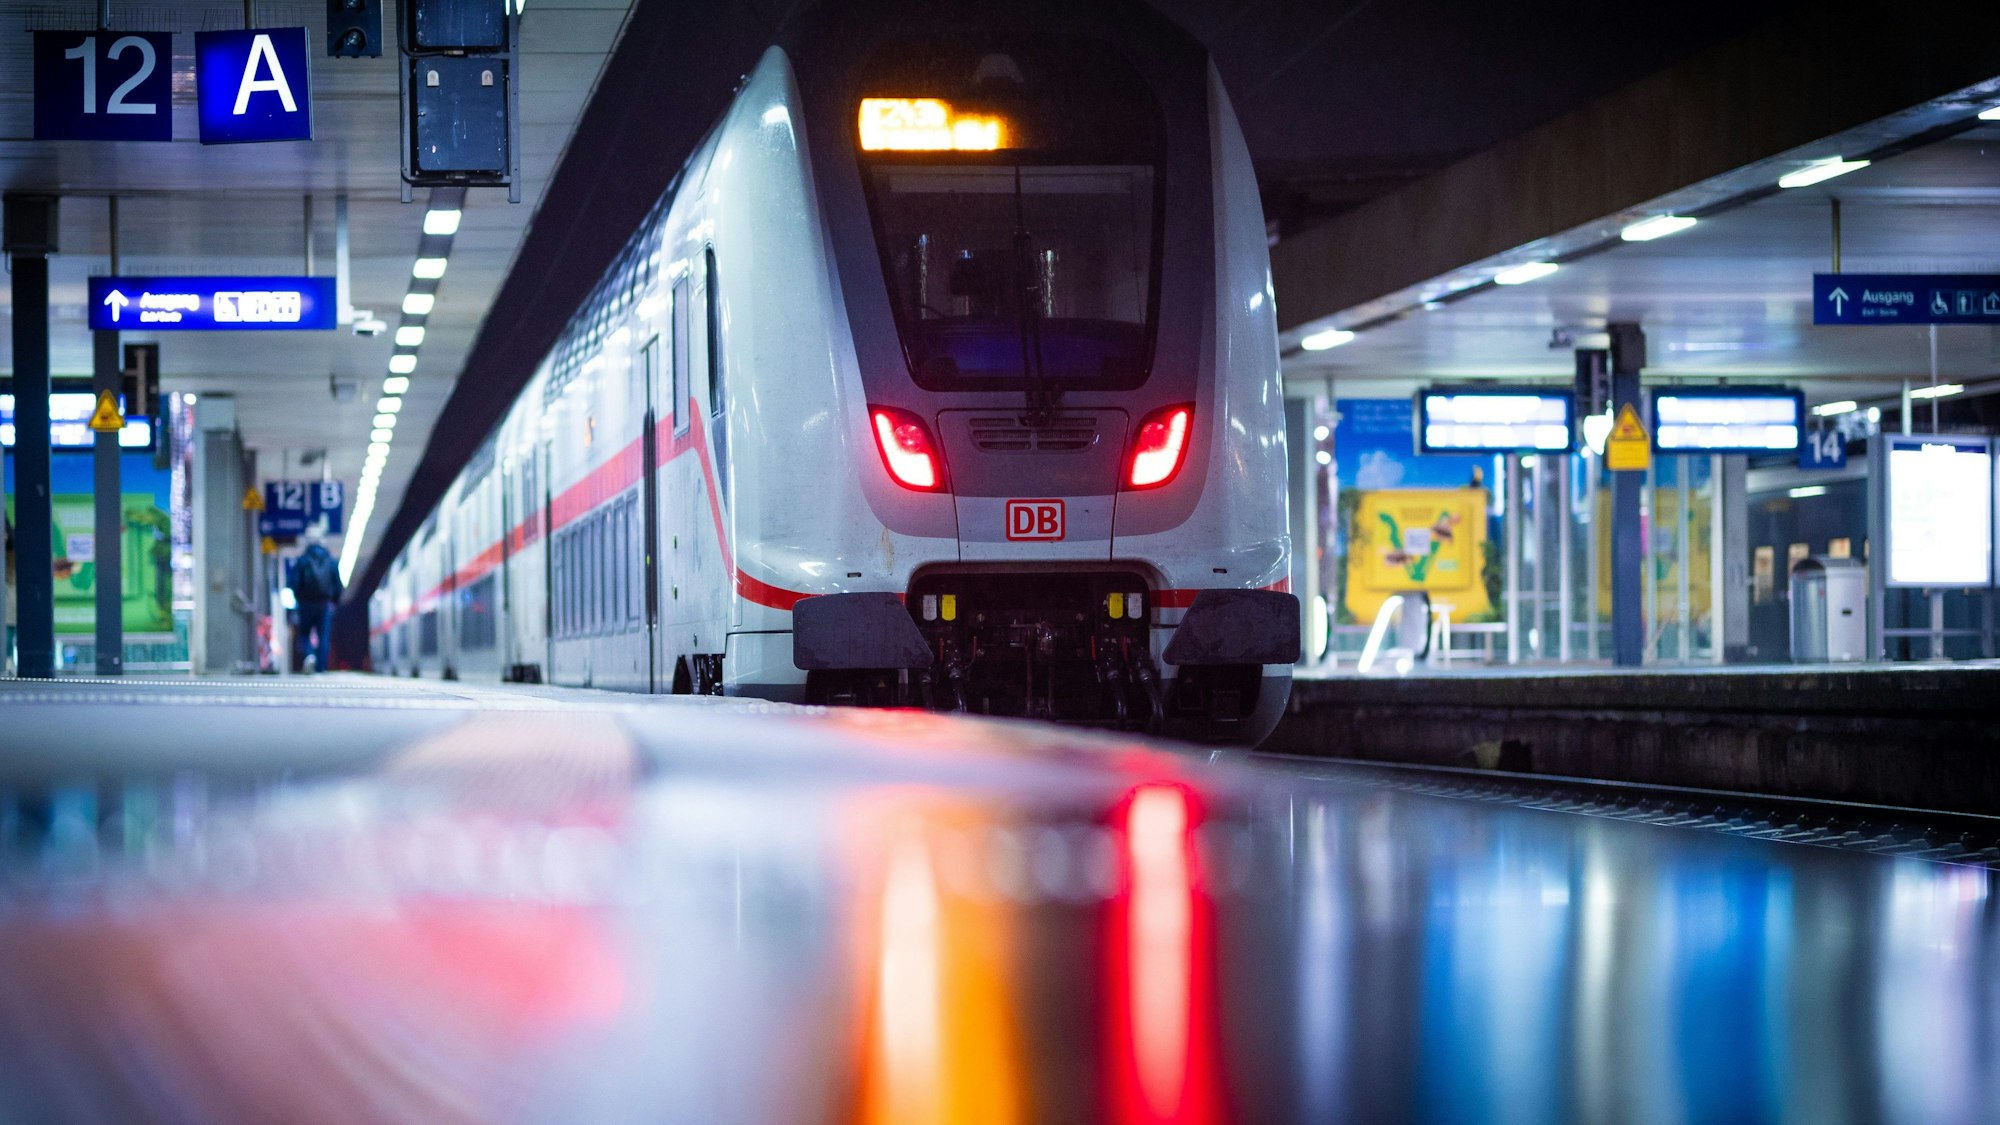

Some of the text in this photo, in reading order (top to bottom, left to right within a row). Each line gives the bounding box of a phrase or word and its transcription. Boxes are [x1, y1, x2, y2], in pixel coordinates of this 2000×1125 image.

[64, 35, 157, 115] 12
[232, 34, 298, 115] A
[1862, 289, 1914, 306] Ausgang
[1807, 431, 1842, 464] 14
[272, 483, 303, 510] 12
[320, 482, 341, 510] B
[1013, 506, 1059, 535] DB
